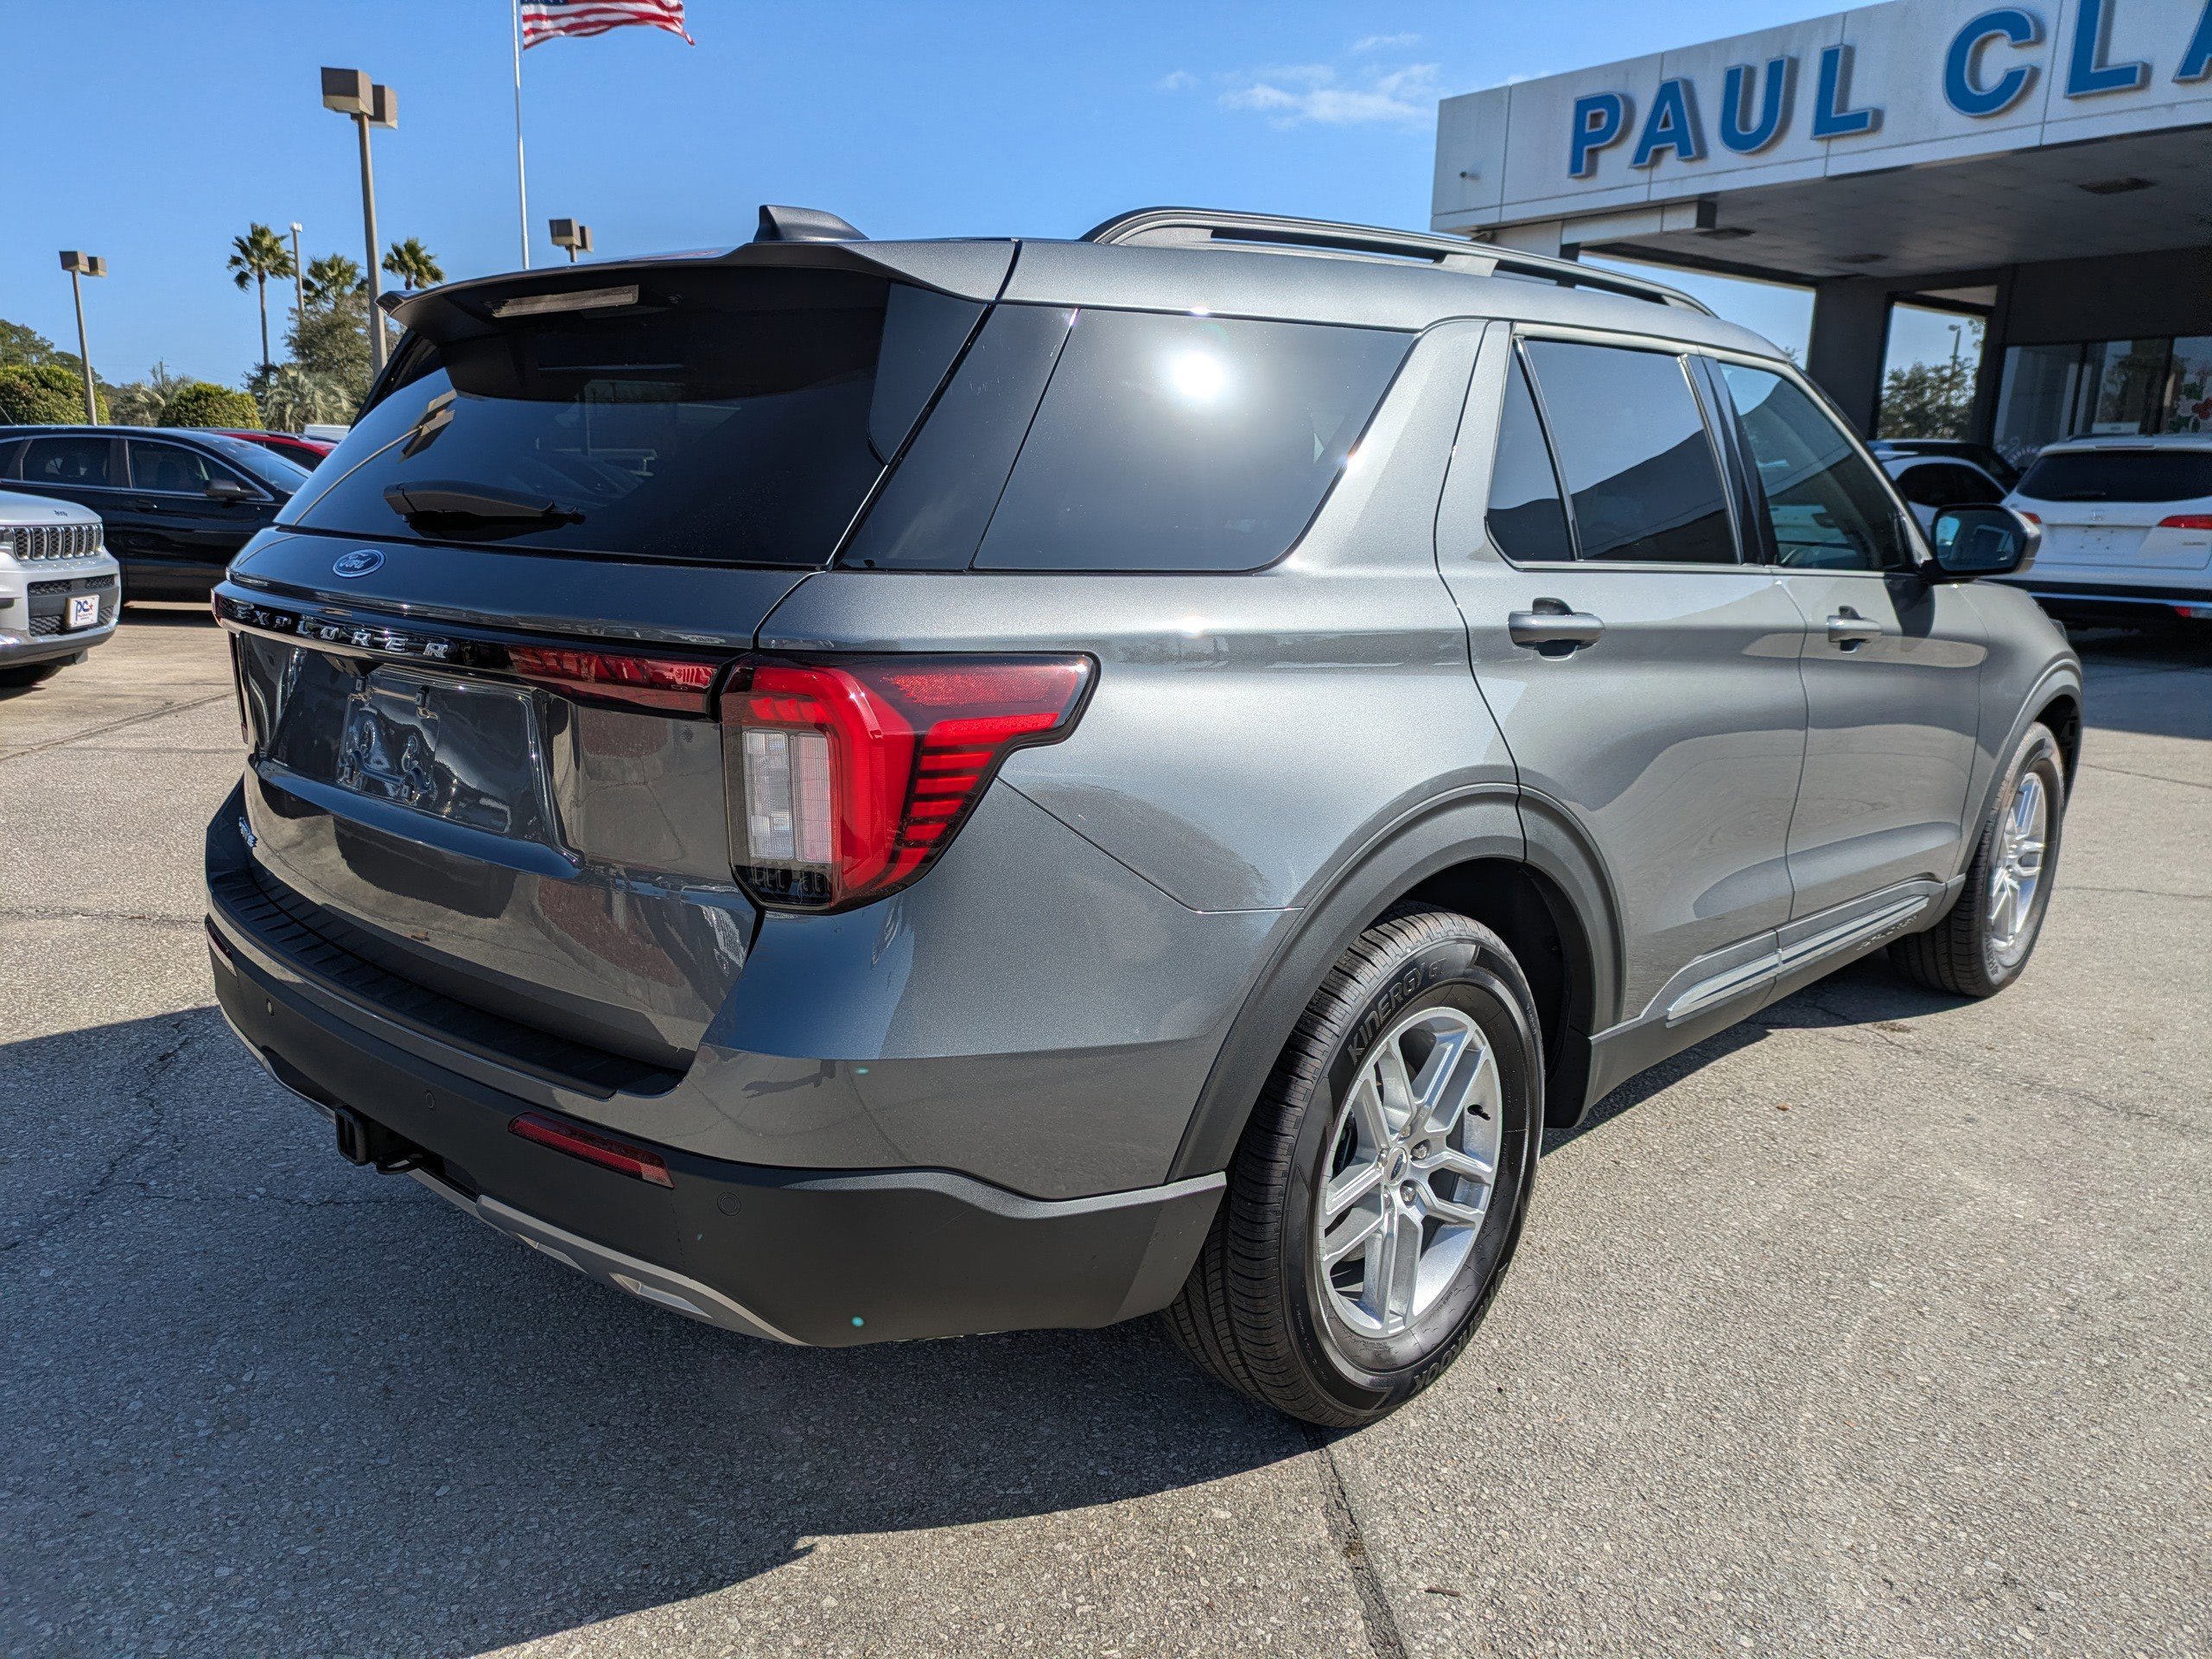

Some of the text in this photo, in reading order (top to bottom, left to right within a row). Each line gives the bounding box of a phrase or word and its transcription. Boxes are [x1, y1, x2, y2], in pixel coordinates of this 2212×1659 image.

[1568, 44, 1878, 178] PAUL
[233, 602, 450, 659] EXPLORER
[1347, 962, 1426, 1066] KINERGY
